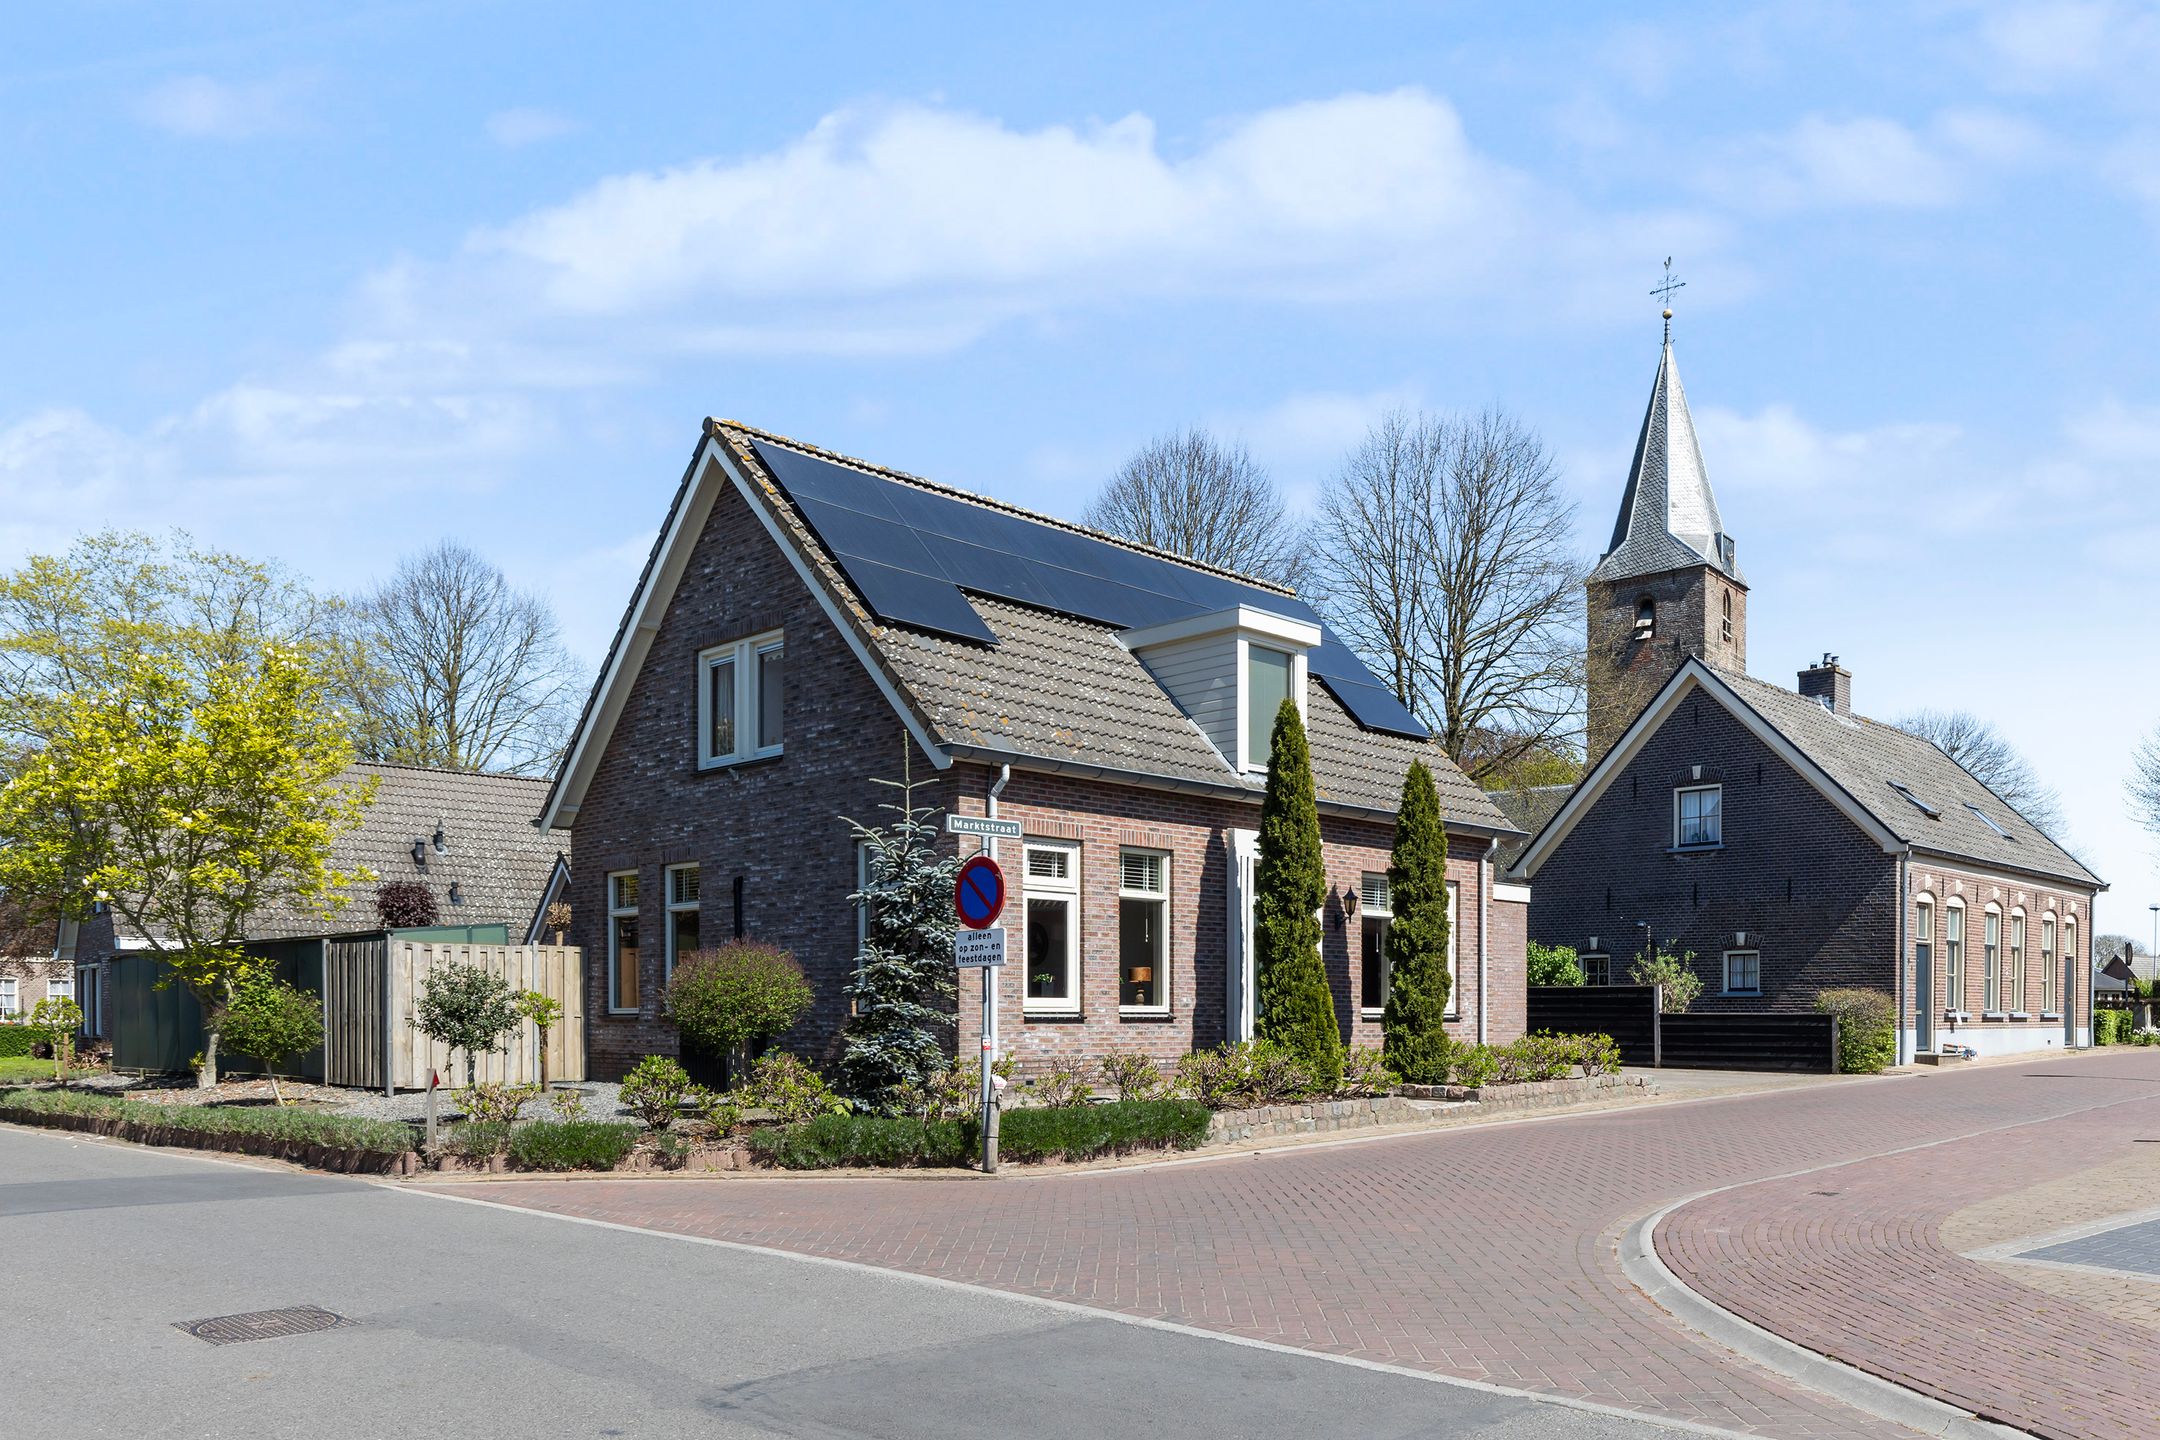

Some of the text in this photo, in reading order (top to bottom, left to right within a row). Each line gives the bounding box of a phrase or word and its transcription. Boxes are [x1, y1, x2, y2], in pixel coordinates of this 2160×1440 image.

[954, 819, 1017, 834] Marktstraat
[967, 931, 992, 941] alleen
[959, 942, 1001, 954] op zon- en
[958, 953, 1002, 964] feestdagen
